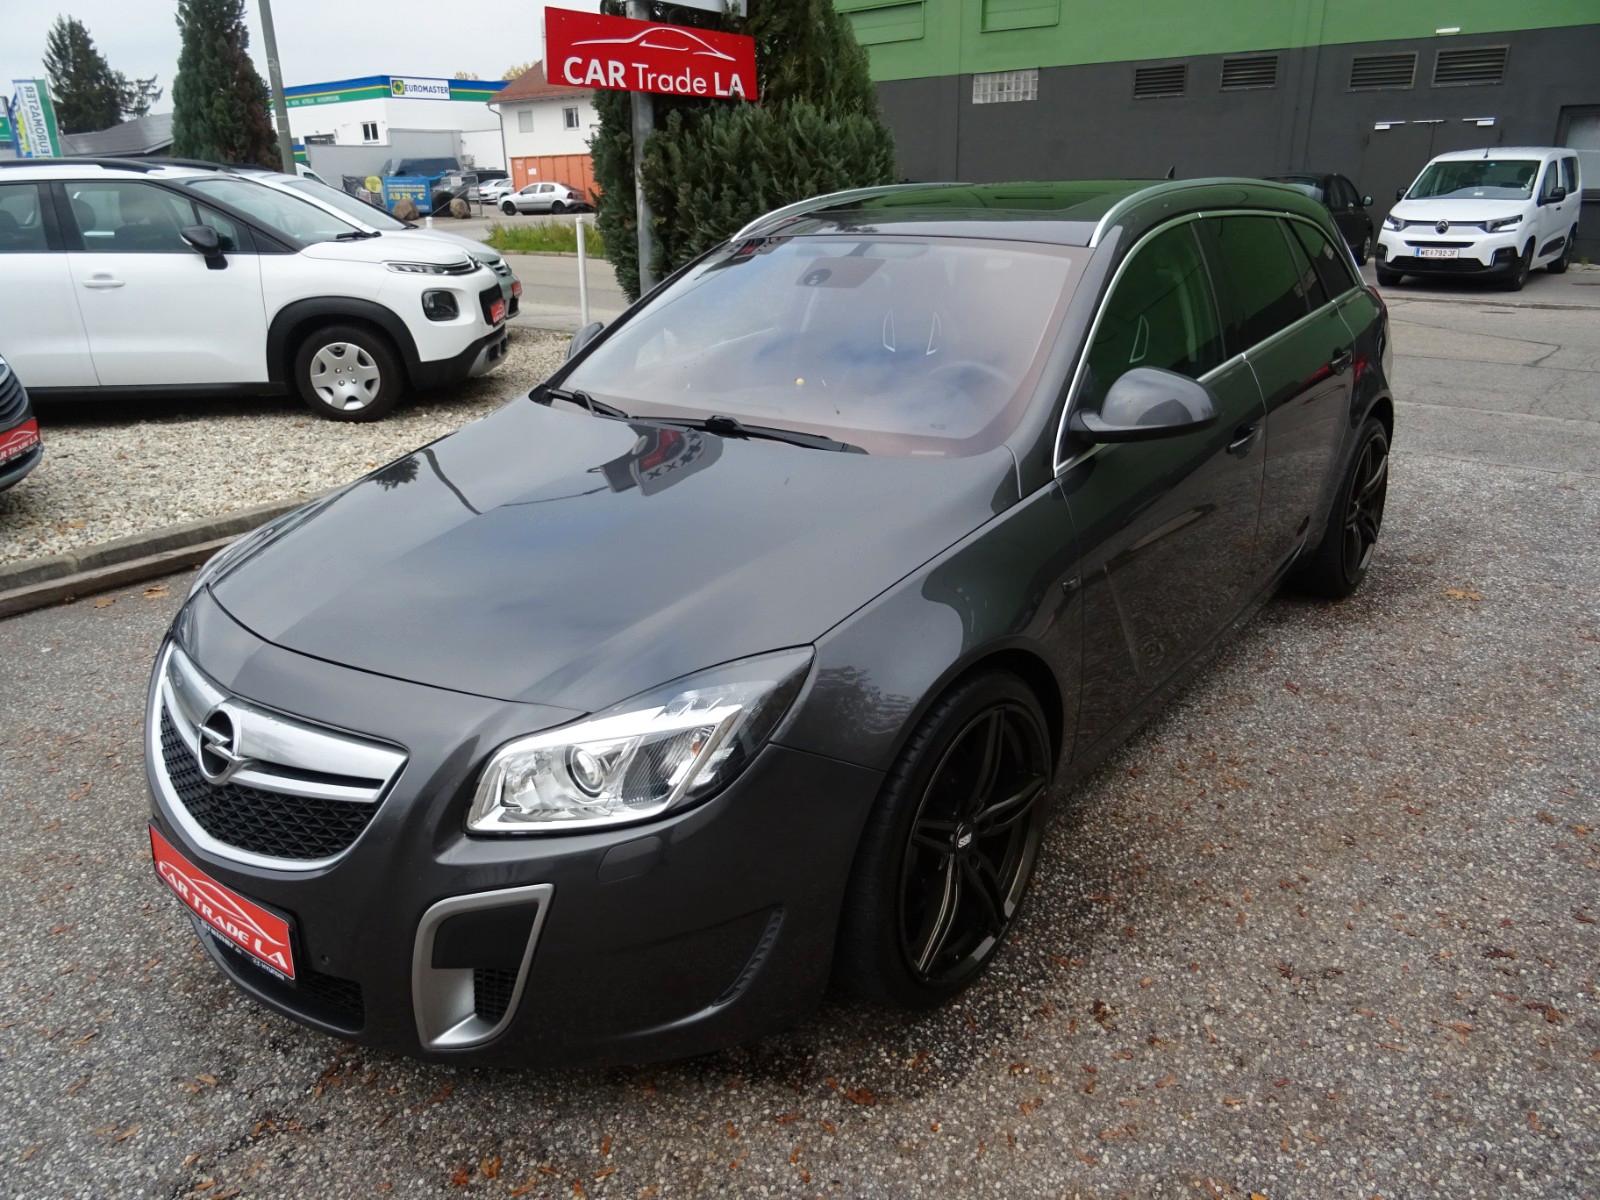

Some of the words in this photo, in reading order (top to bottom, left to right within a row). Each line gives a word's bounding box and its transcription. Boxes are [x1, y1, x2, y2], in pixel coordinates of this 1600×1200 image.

[404, 84, 449, 94] EUROMASTER
[563, 56, 627, 88] CAR
[631, 62, 707, 94] Trade
[714, 71, 745, 97] LA
[159, 860, 188, 898] CAR
[192, 892, 250, 945] TRADE
[254, 938, 289, 970] LA
